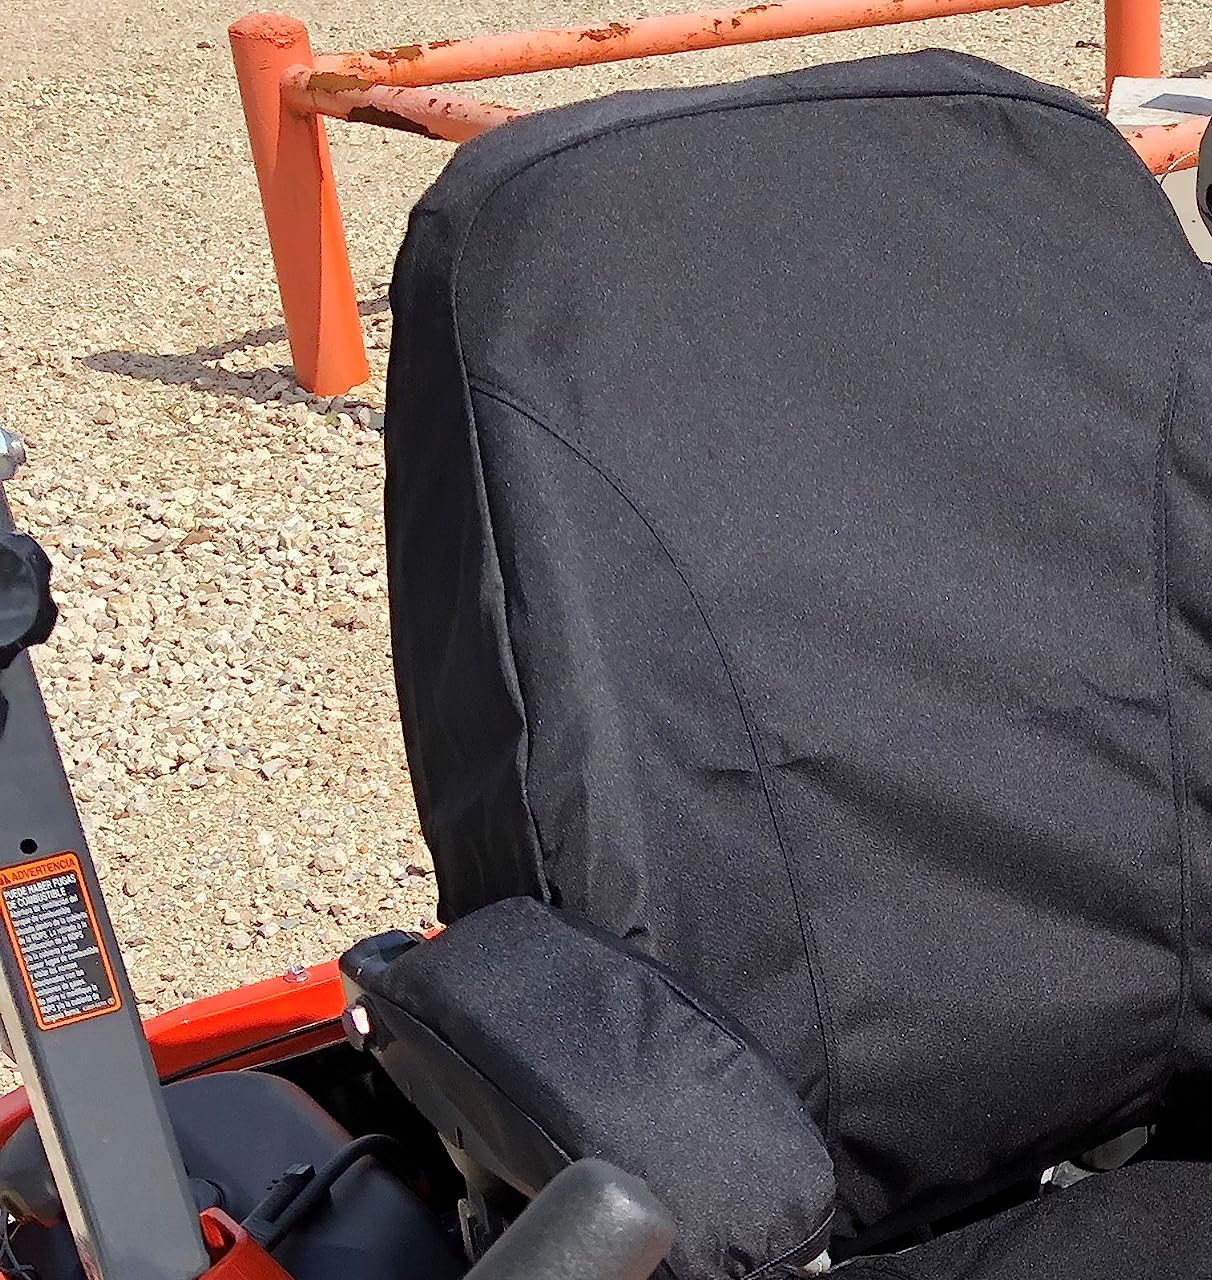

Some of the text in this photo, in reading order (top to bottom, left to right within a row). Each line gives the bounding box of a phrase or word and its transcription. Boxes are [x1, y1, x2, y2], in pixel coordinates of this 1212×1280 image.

[10, 857, 75, 882] ADVERTENCIA
[2, 872, 76, 900] PUEDE HABER FUGAS
[6, 886, 66, 910] DE COMBUSTIBLE
